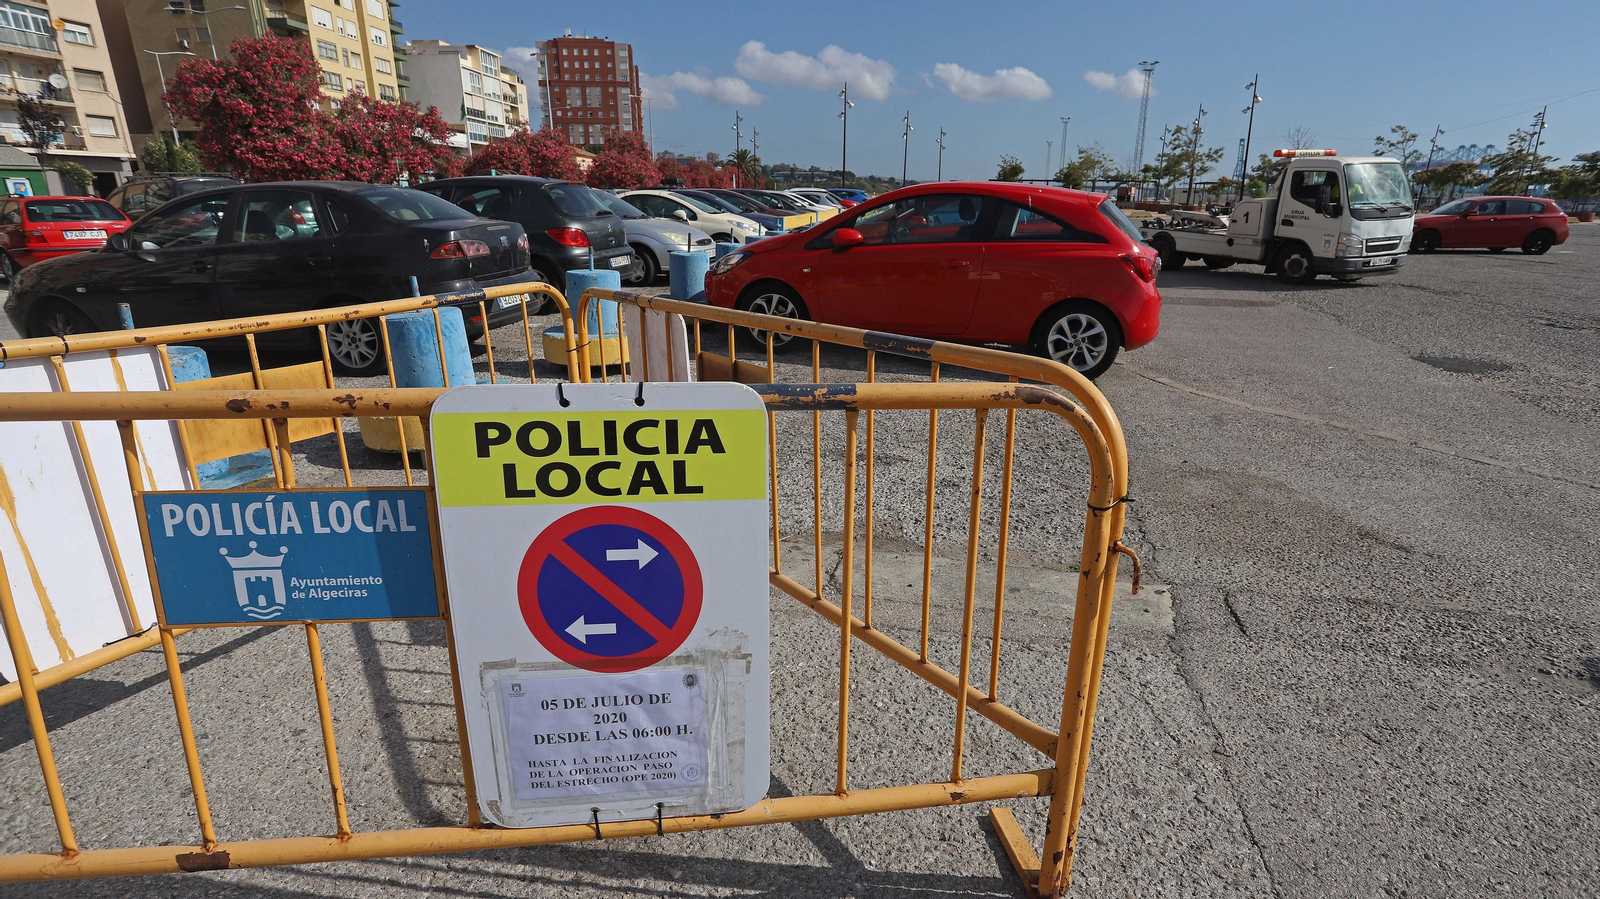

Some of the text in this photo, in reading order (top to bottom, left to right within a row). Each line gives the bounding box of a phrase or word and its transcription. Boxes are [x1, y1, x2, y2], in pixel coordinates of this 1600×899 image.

[1243, 211, 1249, 223] 1
[474, 419, 726, 458] POLICIA
[502, 460, 704, 498] LOCAL
[161, 495, 417, 537] POLICÍA LOCAL
[290, 575, 383, 588] Ayuntamiento
[292, 587, 368, 601] de Algeciras
[540, 692, 672, 711] 05 DE JULIO DE
[593, 711, 628, 725] 2020
[533, 724, 693, 745] DESDE LAS 06:00 H.
[528, 750, 678, 768] HASTA LA FINALIZACION
[529, 761, 673, 779] DE LA OPERACION PASO
[531, 780, 554, 789] DEL
[557, 775, 619, 788] ESTRECHO
[621, 773, 648, 784] (OPE
[650, 771, 677, 781] 2020)
